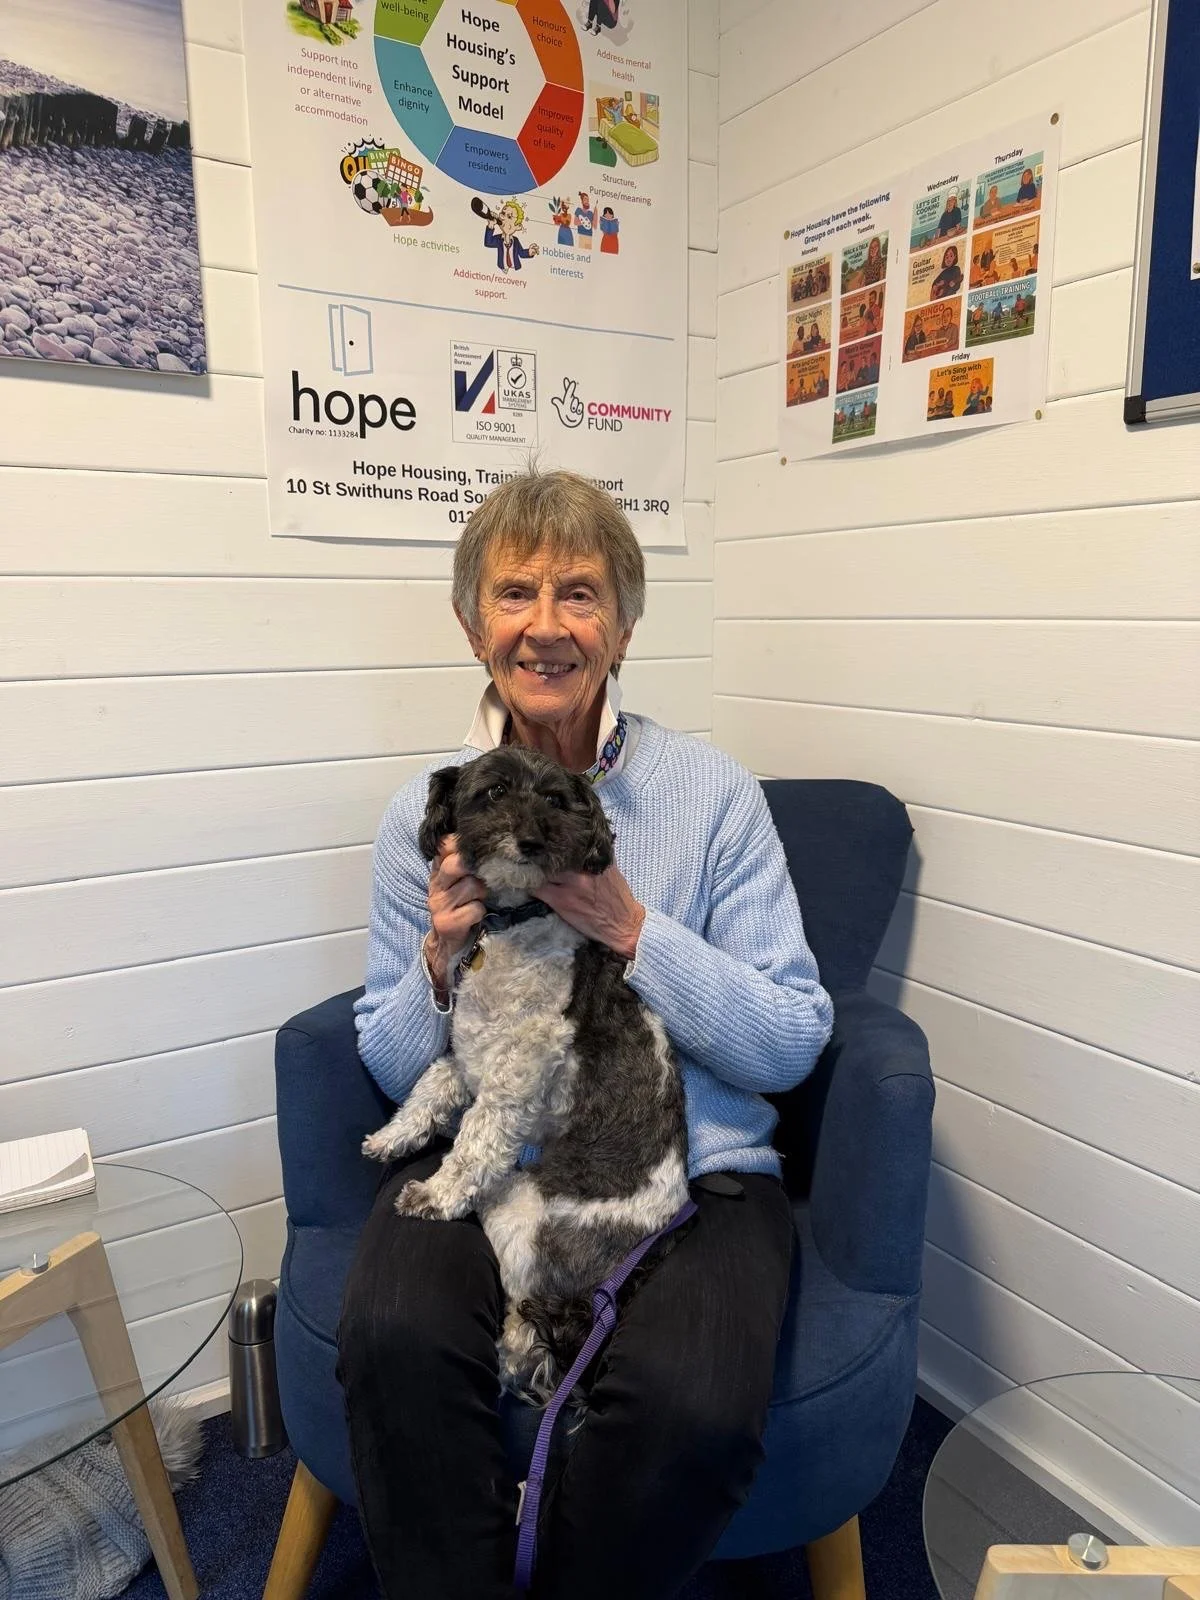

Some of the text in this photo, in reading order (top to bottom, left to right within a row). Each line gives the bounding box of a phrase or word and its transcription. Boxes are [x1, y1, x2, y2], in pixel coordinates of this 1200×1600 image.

[381, 1, 429, 22] well-being
[461, 9, 500, 32] Hope
[532, 16, 567, 34] Honours
[446, 32, 516, 65] Housing's
[536, 33, 563, 48] choice
[301, 47, 358, 70] Support into
[597, 48, 652, 70] Address mental
[287, 63, 373, 94] independent living
[452, 64, 510, 94] Support
[611, 68, 635, 82] health
[300, 86, 362, 107] or alternative
[393, 80, 433, 97] Enhance
[398, 98, 430, 114] dignity
[458, 95, 504, 120] Model
[538, 106, 574, 123] Improves
[294, 104, 368, 126] accommodation
[537, 123, 564, 137] quality
[464, 143, 510, 161] Empowers
[533, 138, 556, 151] of life
[994, 148, 1023, 165] Thursday
[391, 156, 421, 175] BINGO
[468, 160, 507, 175] residents
[602, 173, 638, 189] Structure,
[927, 174, 959, 192] Wednesday
[589, 185, 652, 207] Purpose/meaning
[931, 195, 940, 204] GET
[790, 192, 890, 239] Hope Housing have the following
[916, 202, 940, 215] COOKING
[804, 213, 872, 245] Groups on each week.
[857, 224, 875, 235] Tuesday
[393, 233, 461, 254] Hope activities
[801, 246, 818, 256] Monday
[542, 246, 591, 263] Hobbies and
[912, 257, 931, 269] Guitar
[550, 265, 585, 279] interests
[805, 257, 826, 270] PROJECT
[912, 264, 935, 276] Lessons
[453, 268, 527, 288] Addiction/recovery
[474, 287, 508, 300] support.
[971, 289, 1000, 302] FOOTBALL
[1001, 282, 1030, 295] TRAINING
[920, 303, 945, 318] BINGO
[952, 353, 970, 361] Friday
[953, 366, 967, 375] Sing
[968, 363, 982, 371] with
[503, 389, 532, 399] UKAS
[292, 370, 416, 439] hope
[587, 402, 672, 422] COMMUNITY
[288, 425, 359, 438] Charity no: 1133284
[476, 420, 516, 433] ISO 9001
[588, 417, 623, 432] FUND
[489, 435, 526, 443] MANAGEMENT
[353, 460, 397, 480] Hope
[402, 464, 471, 486] Housing,
[286, 478, 307, 494] 10
[312, 480, 331, 496] St
[336, 482, 413, 501] Swithuns
[418, 487, 459, 503] Road
[615, 498, 670, 515] BH1 3RQ
